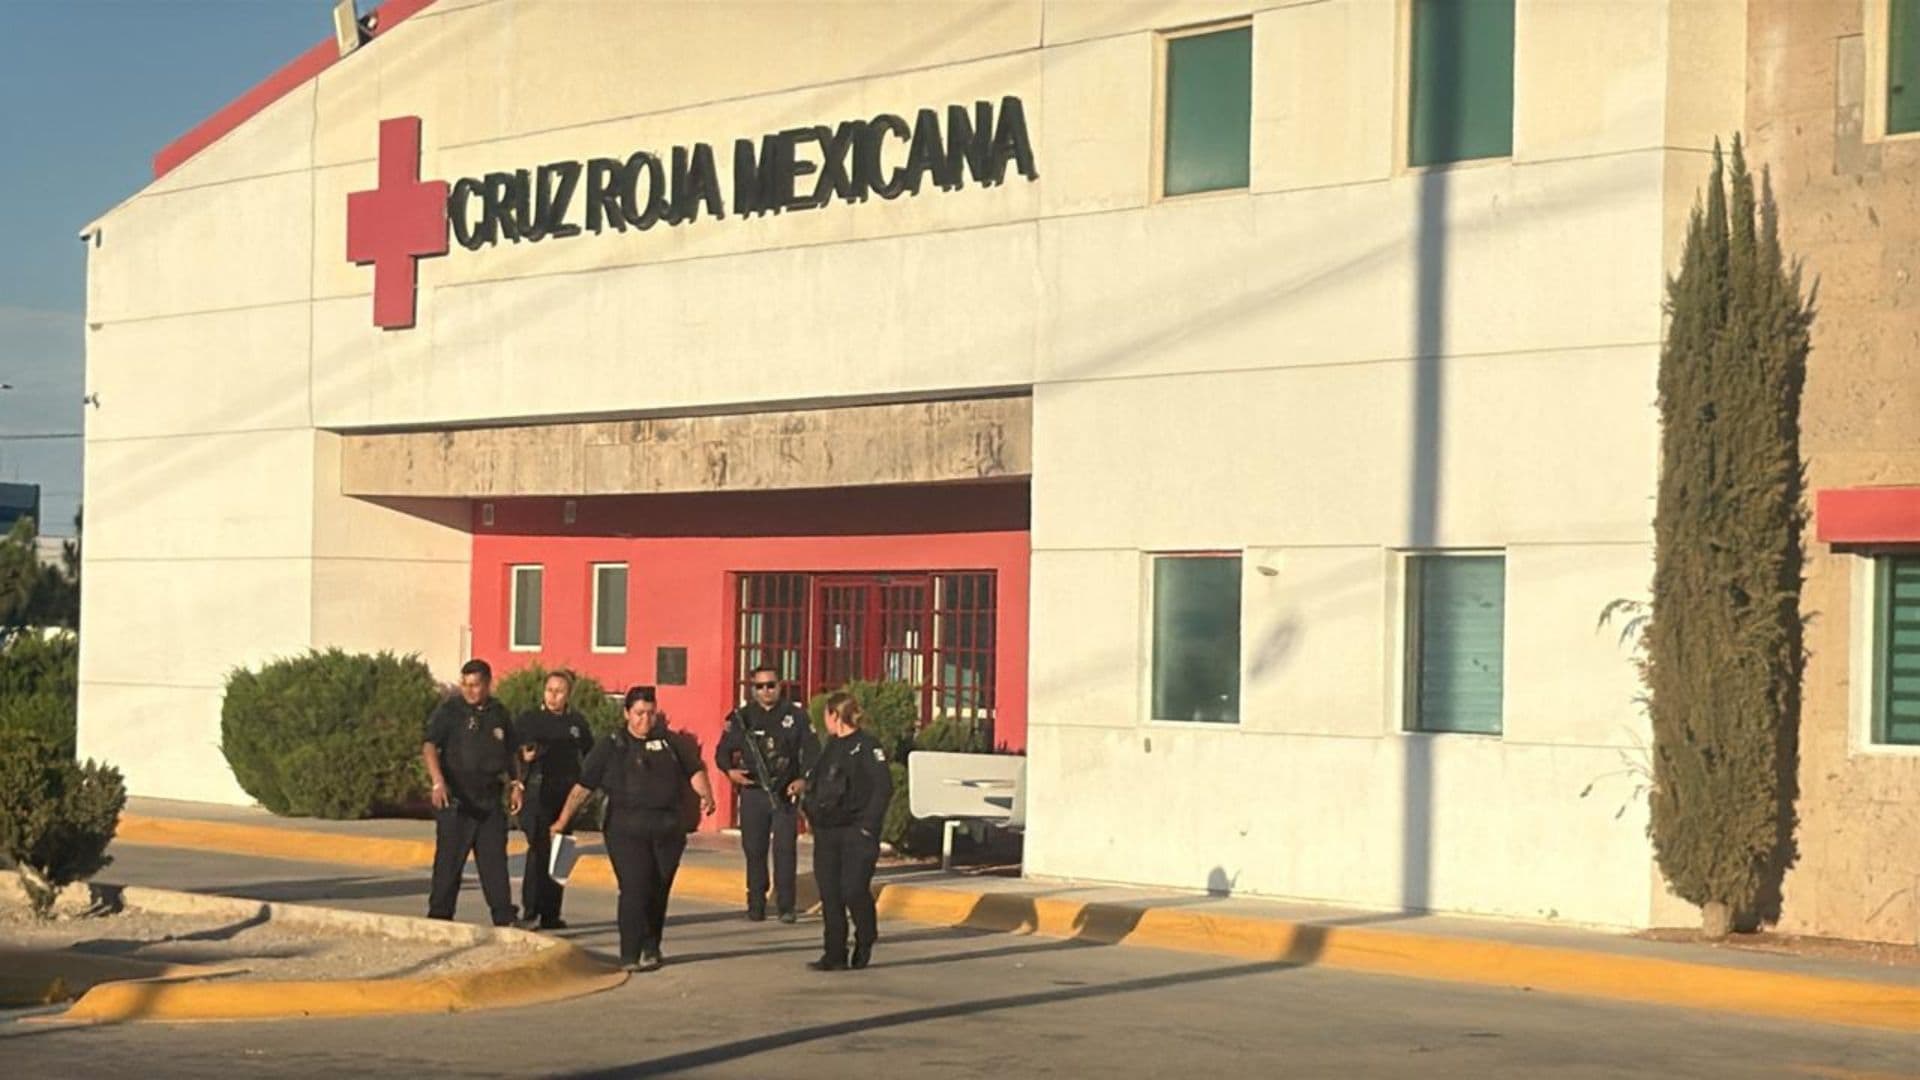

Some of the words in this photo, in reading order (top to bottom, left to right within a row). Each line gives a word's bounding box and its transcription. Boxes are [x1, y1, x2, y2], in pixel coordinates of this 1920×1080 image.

[450, 161, 583, 250] CRUZ
[585, 142, 725, 235] ROJA
[733, 95, 1039, 220] MEXICANA
